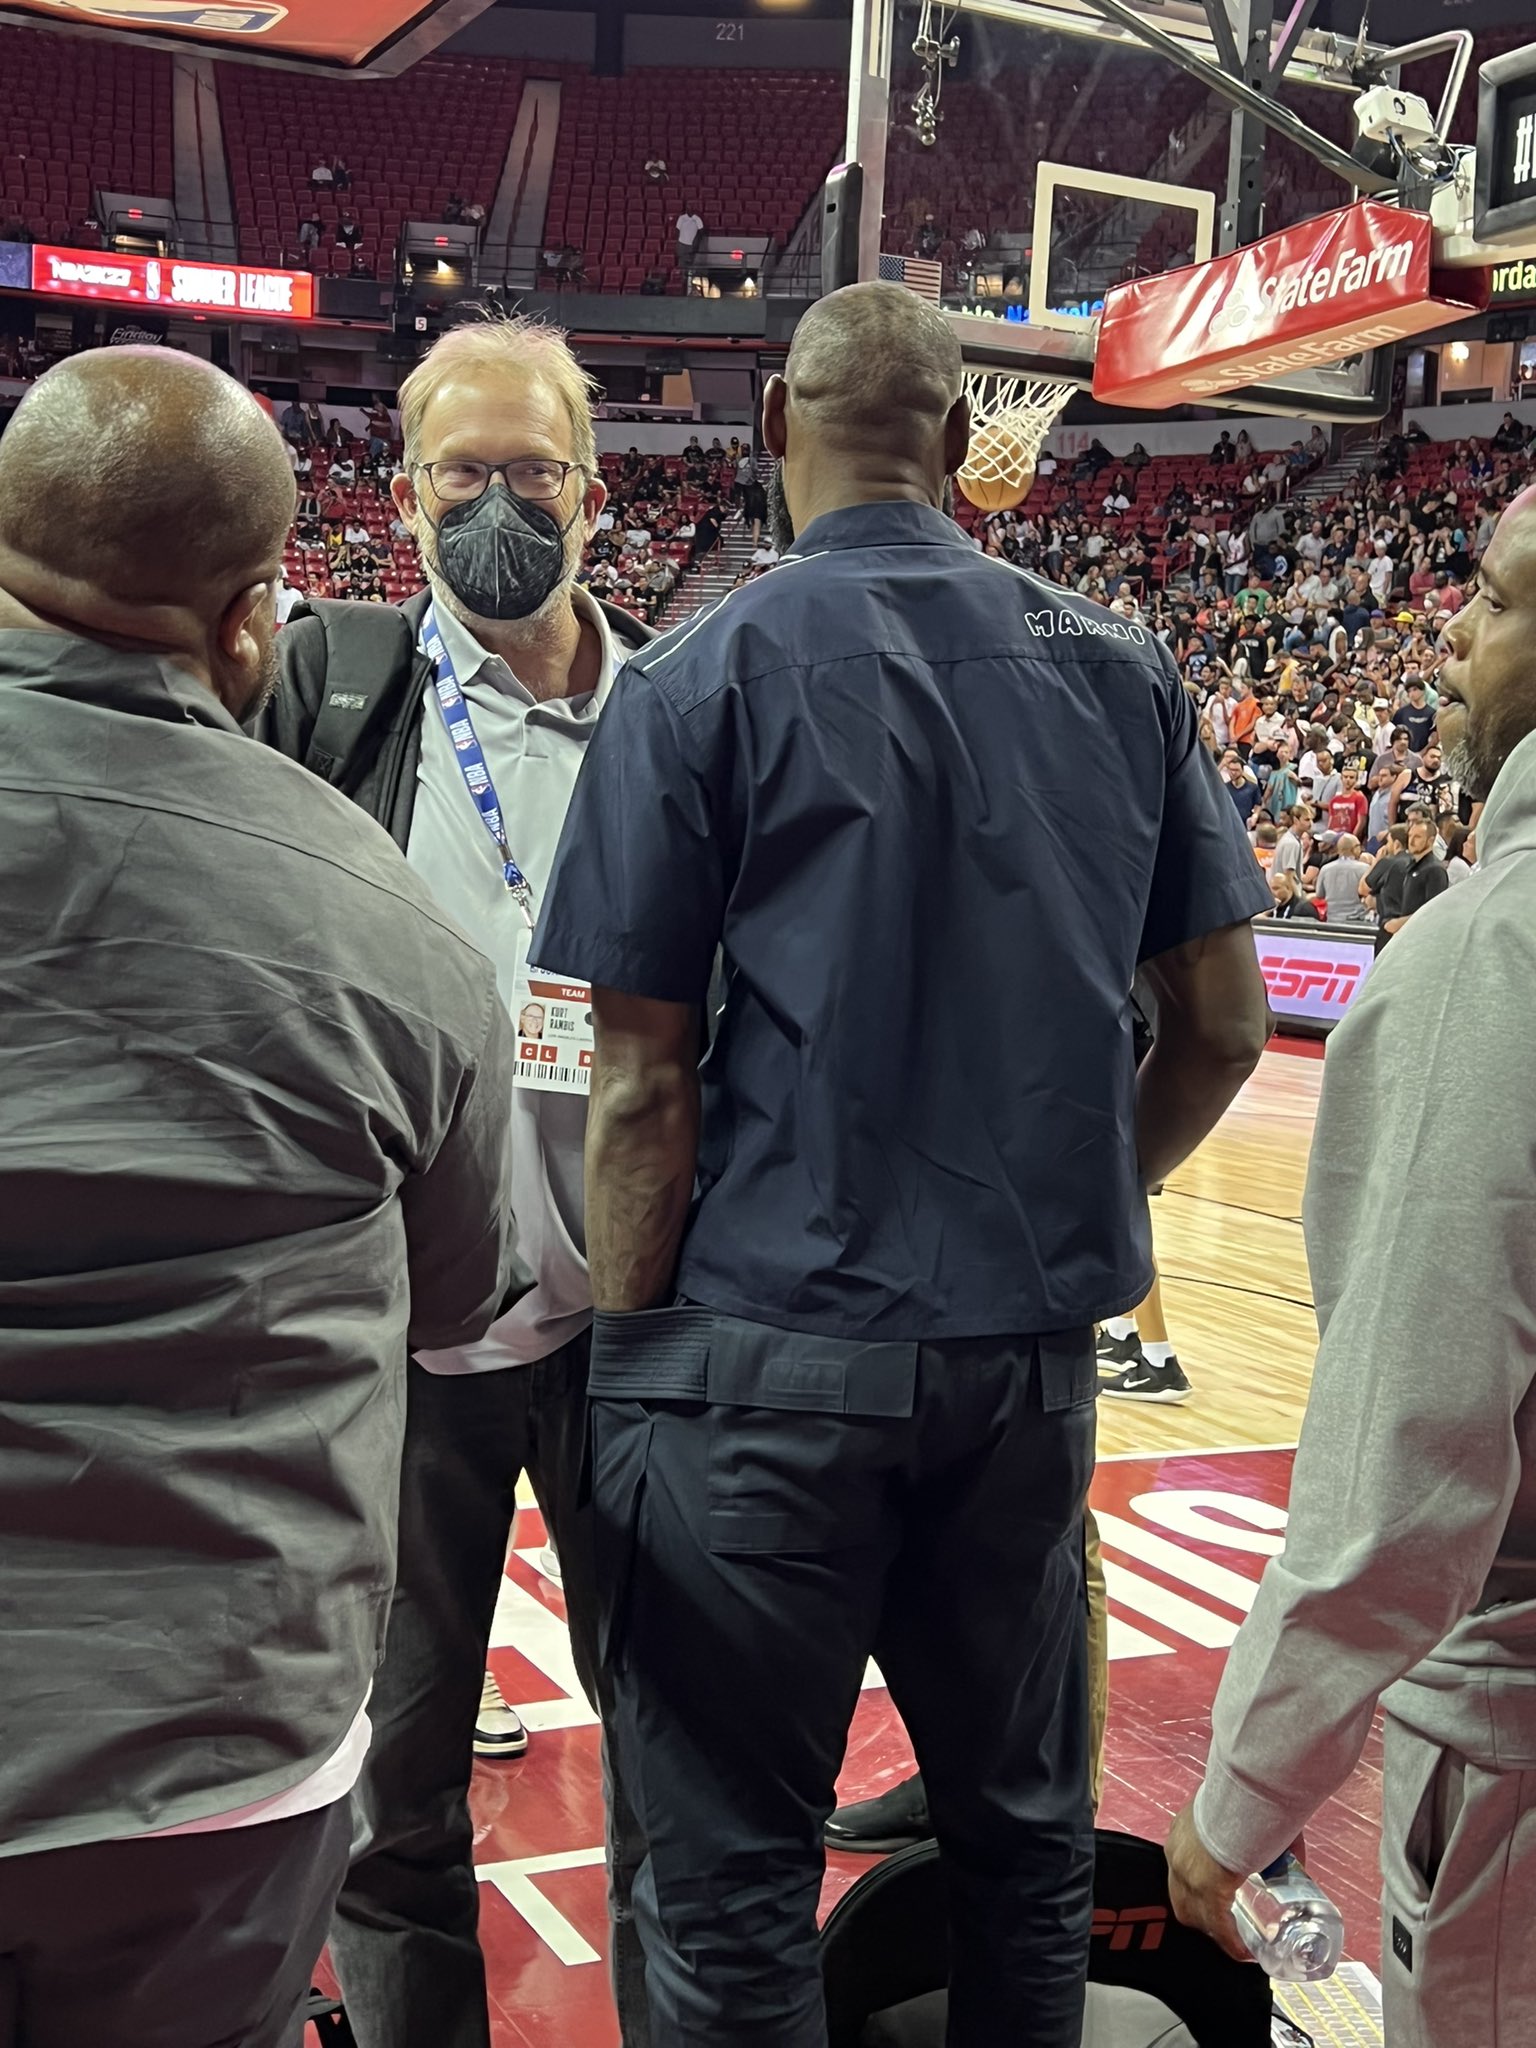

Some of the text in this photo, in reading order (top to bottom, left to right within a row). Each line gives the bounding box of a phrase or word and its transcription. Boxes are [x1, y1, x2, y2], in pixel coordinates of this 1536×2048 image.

[715, 23, 744, 41] 221
[239, 272, 294, 312] LEAGUE
[1057, 431, 1089, 455] 114
[1024, 609, 1146, 645] MARNI
[436, 675, 459, 700] NBA
[450, 719, 474, 743] NBA
[464, 762, 488, 786] NBA
[481, 807, 502, 832] NBA
[1260, 955, 1361, 1005] ESPN
[561, 988, 585, 998] TEAM
[551, 1007, 568, 1018] KURT
[550, 1019, 575, 1031] RAMBIS
